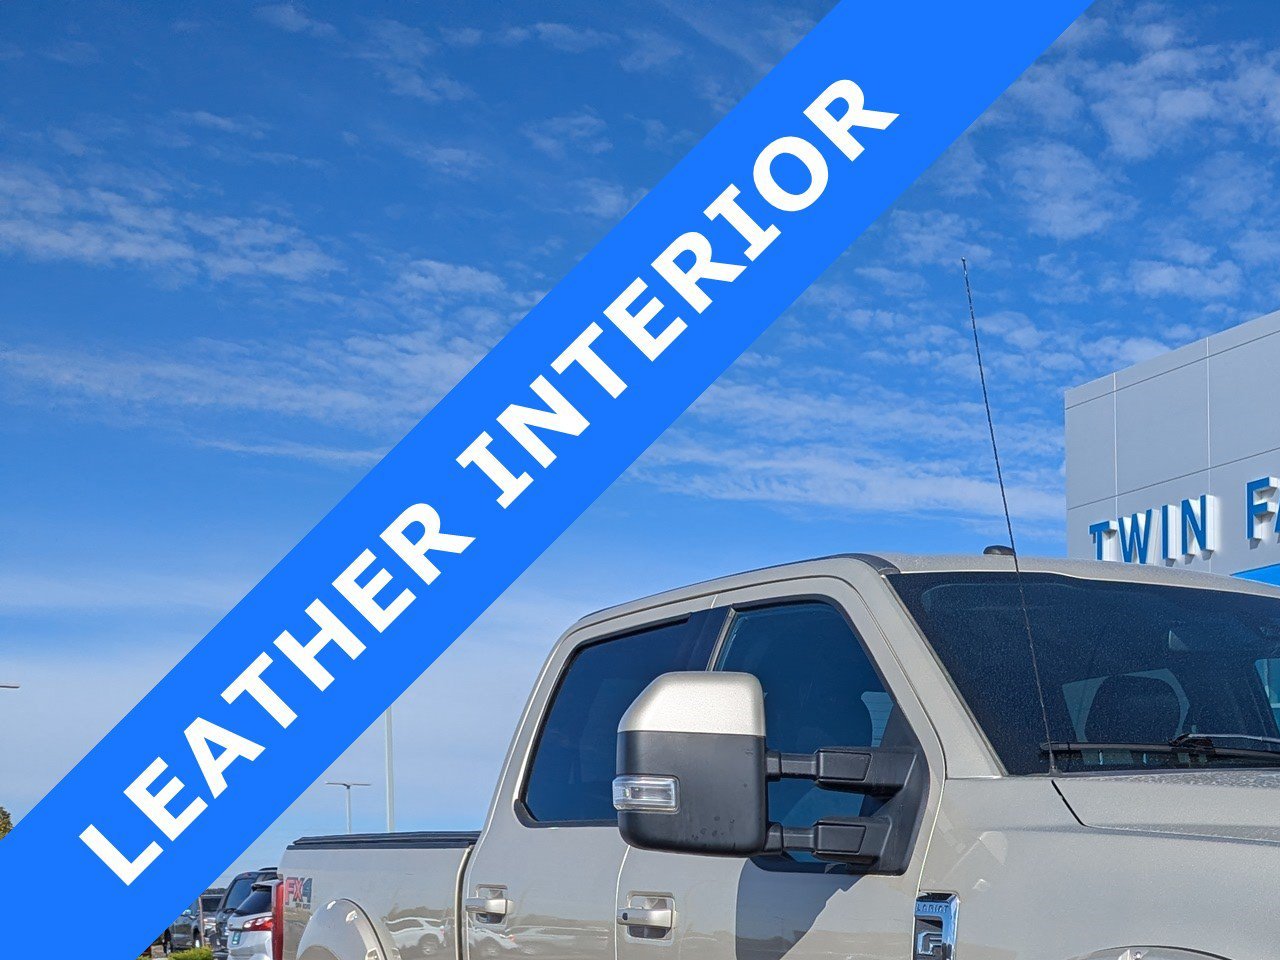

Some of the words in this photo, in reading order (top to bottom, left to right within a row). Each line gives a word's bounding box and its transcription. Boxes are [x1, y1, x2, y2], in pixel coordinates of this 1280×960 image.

[1089, 494, 1213, 564] TWIN
[285, 876, 313, 906] FX4
[916, 903, 950, 913] LARIAT
